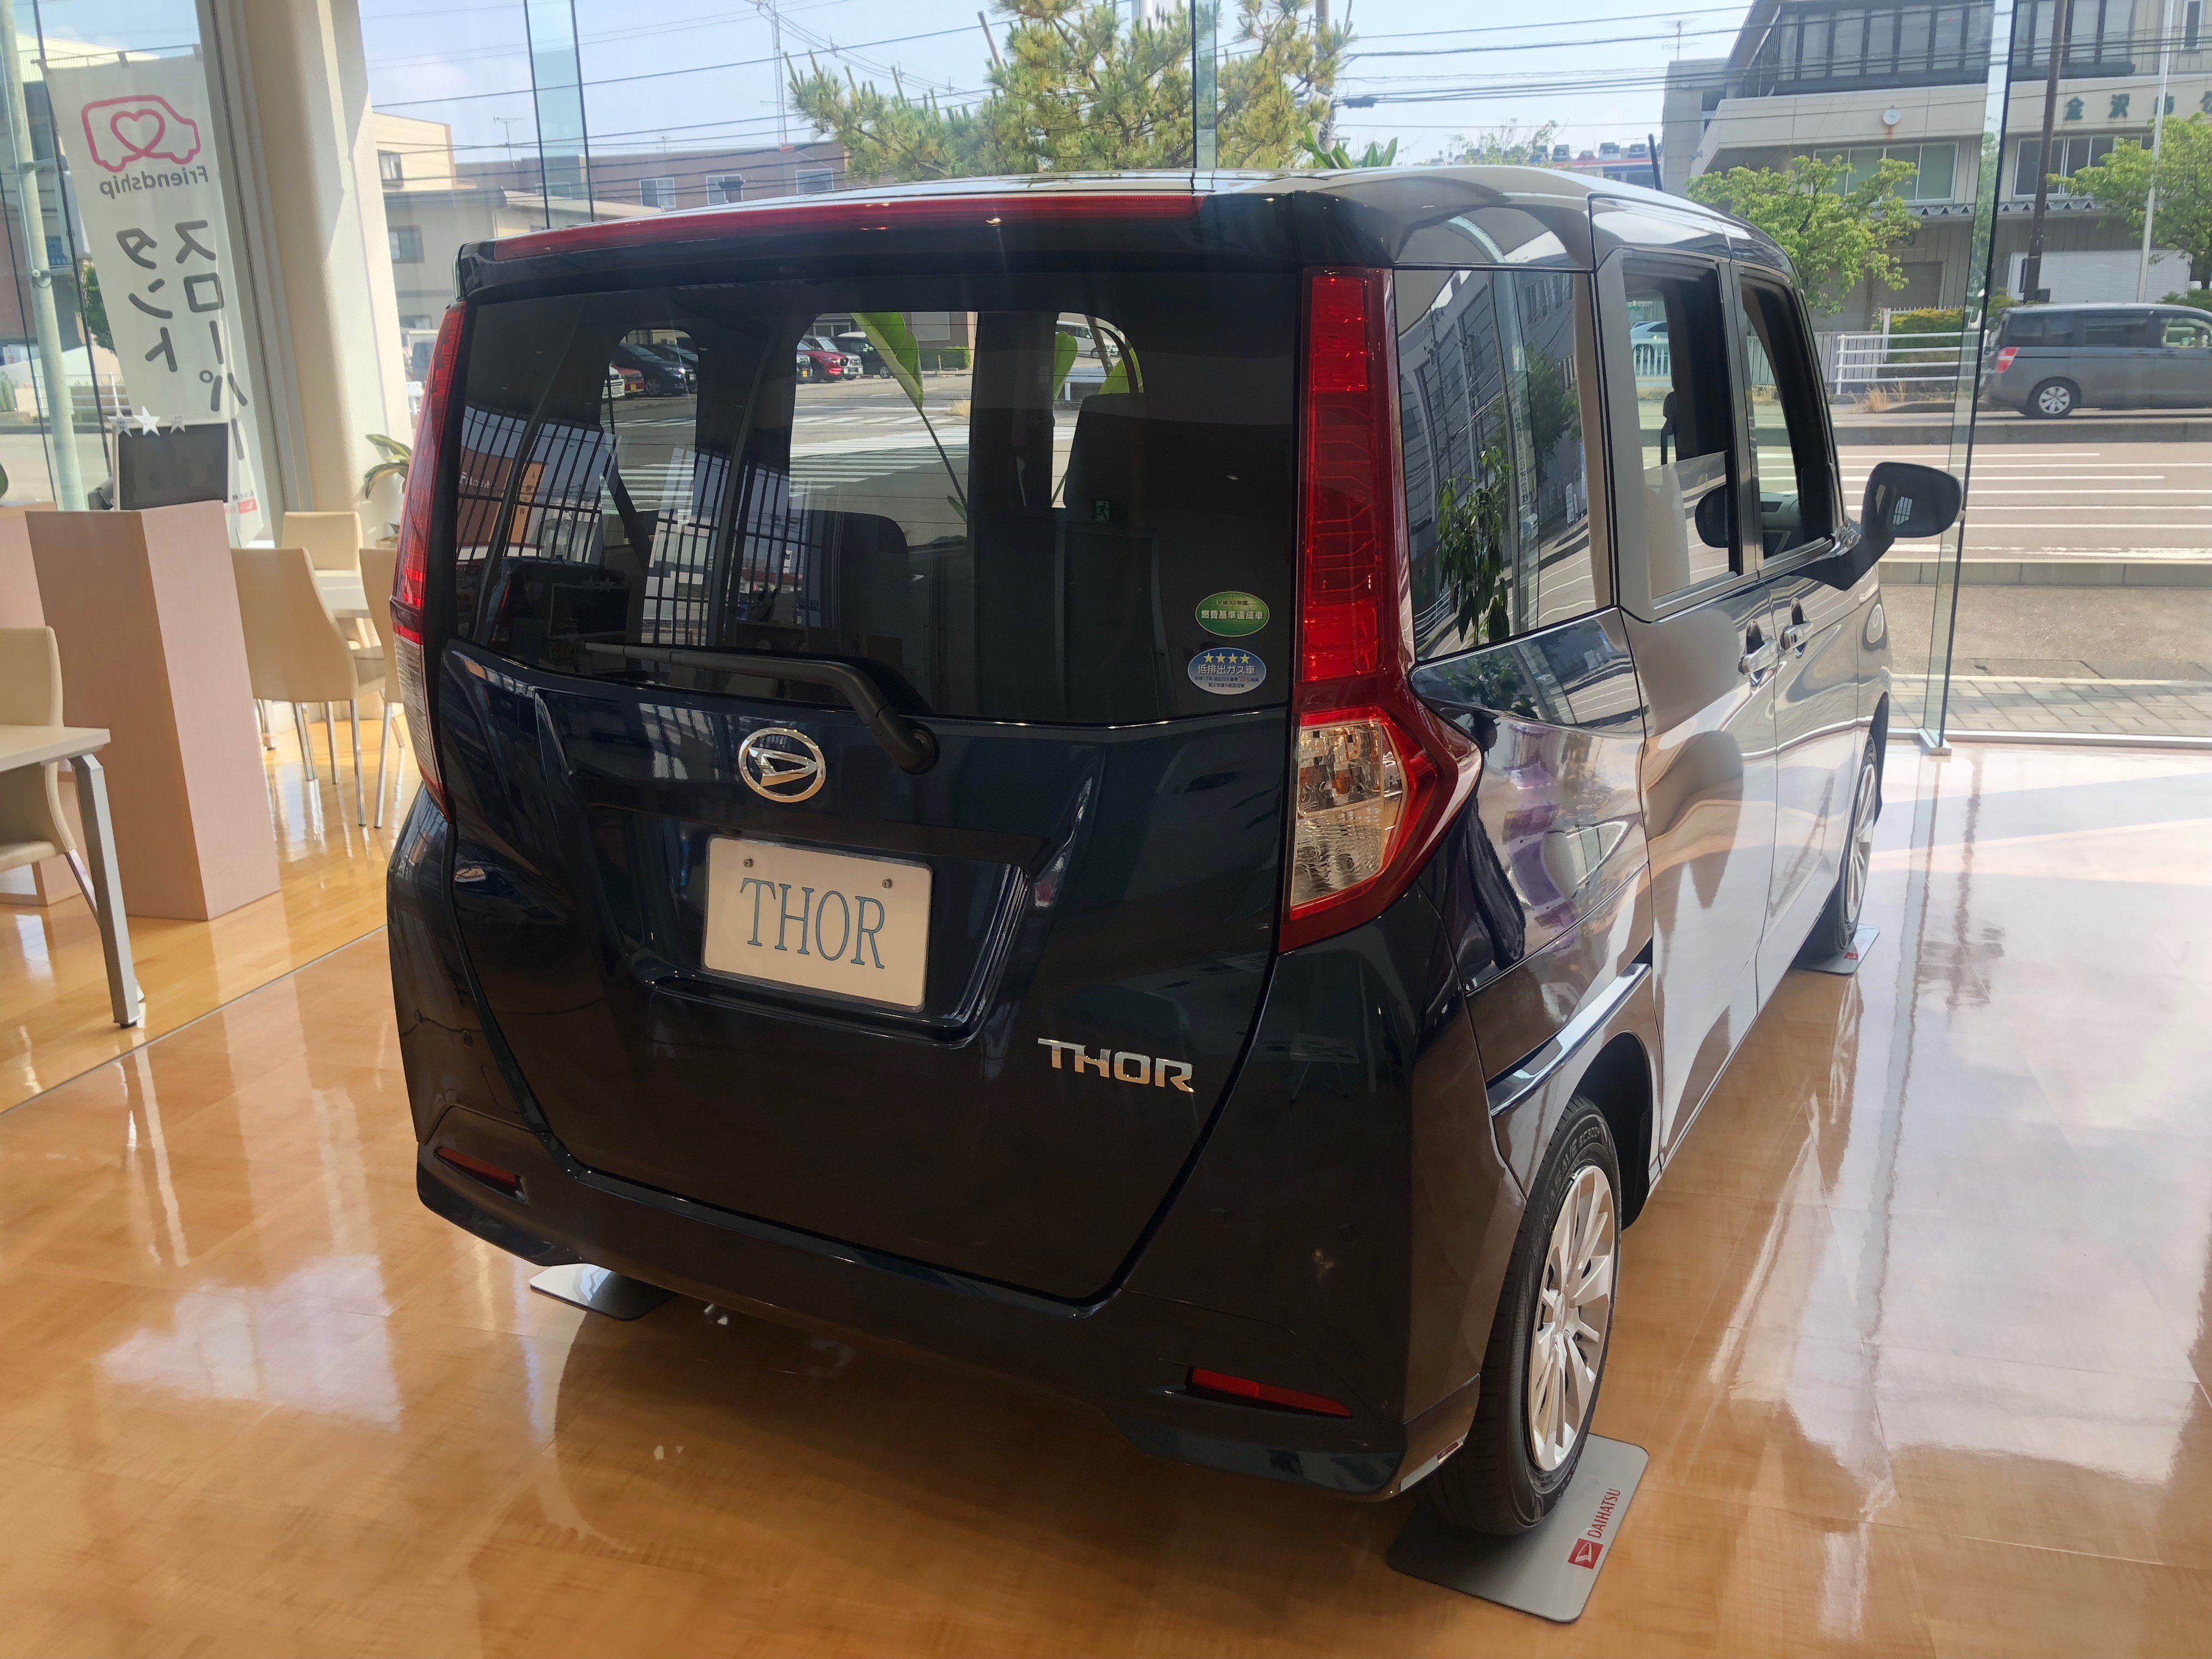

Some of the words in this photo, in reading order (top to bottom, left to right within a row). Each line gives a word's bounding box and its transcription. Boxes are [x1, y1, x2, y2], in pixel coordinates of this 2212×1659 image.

[1201, 610, 1263, 620] 燃費基準達成車
[1198, 664, 1255, 675] 低排出ガス車
[740, 877, 885, 969] THOR
[1038, 1037, 1194, 1093] THOR
[1587, 1488, 1621, 1538] DAIHATSU
